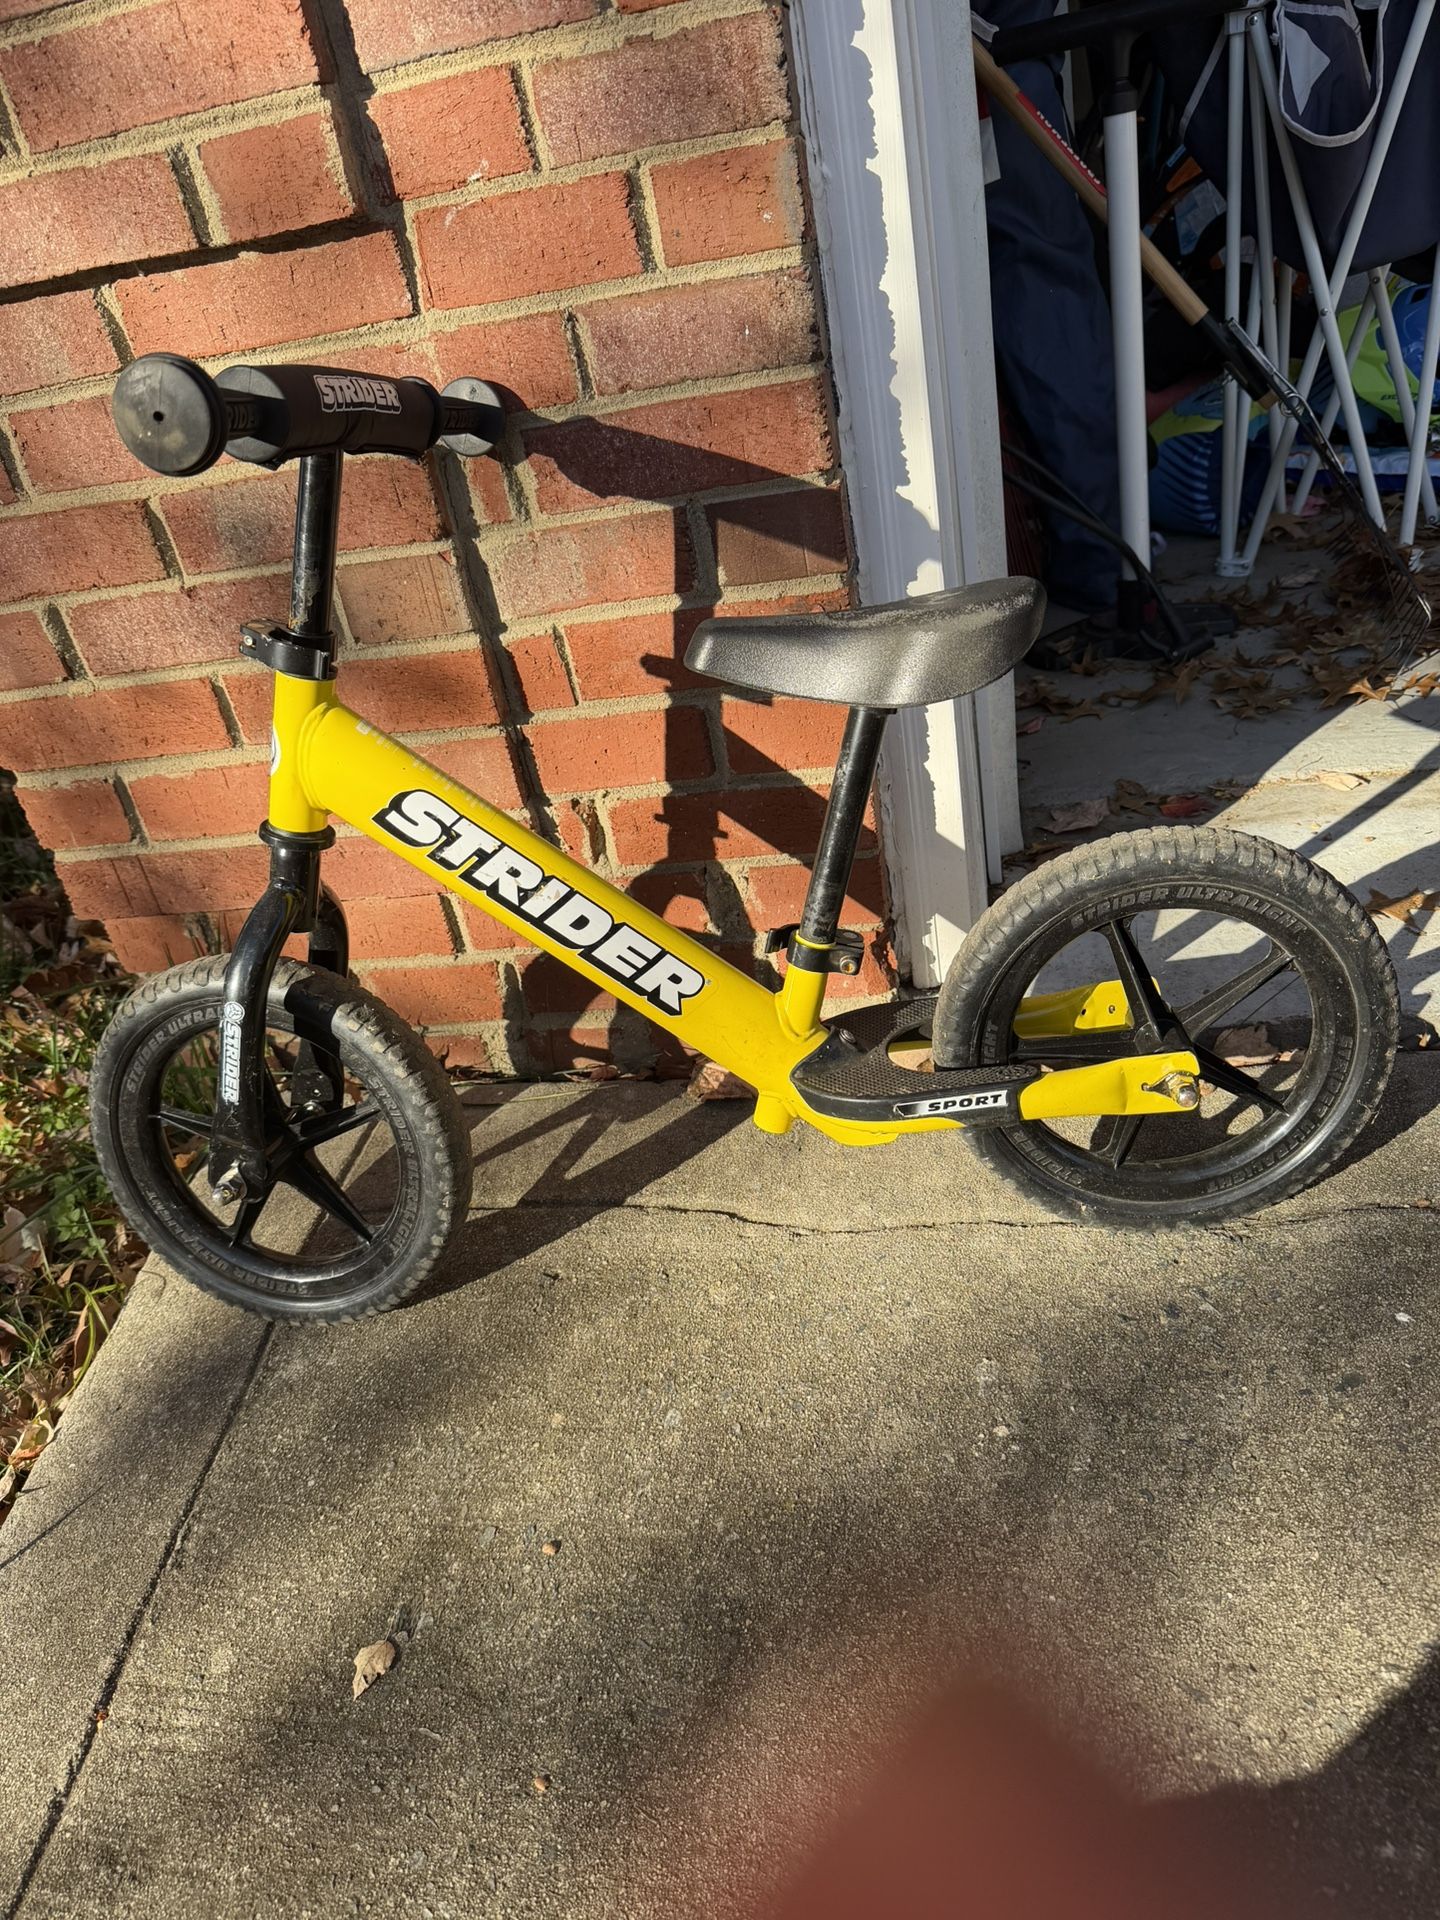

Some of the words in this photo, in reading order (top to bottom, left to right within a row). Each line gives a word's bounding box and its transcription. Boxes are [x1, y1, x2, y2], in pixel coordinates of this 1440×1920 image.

[313, 374, 402, 414] STRIDER
[371, 789, 705, 1016] STRIDER
[1070, 887, 1169, 929] STRIDER
[1176, 886, 1308, 934] ULTRALIGHT
[126, 1029, 168, 1093] STRIDER
[222, 1019, 241, 1105] STRIDER
[928, 1093, 1002, 1112] SPORT
